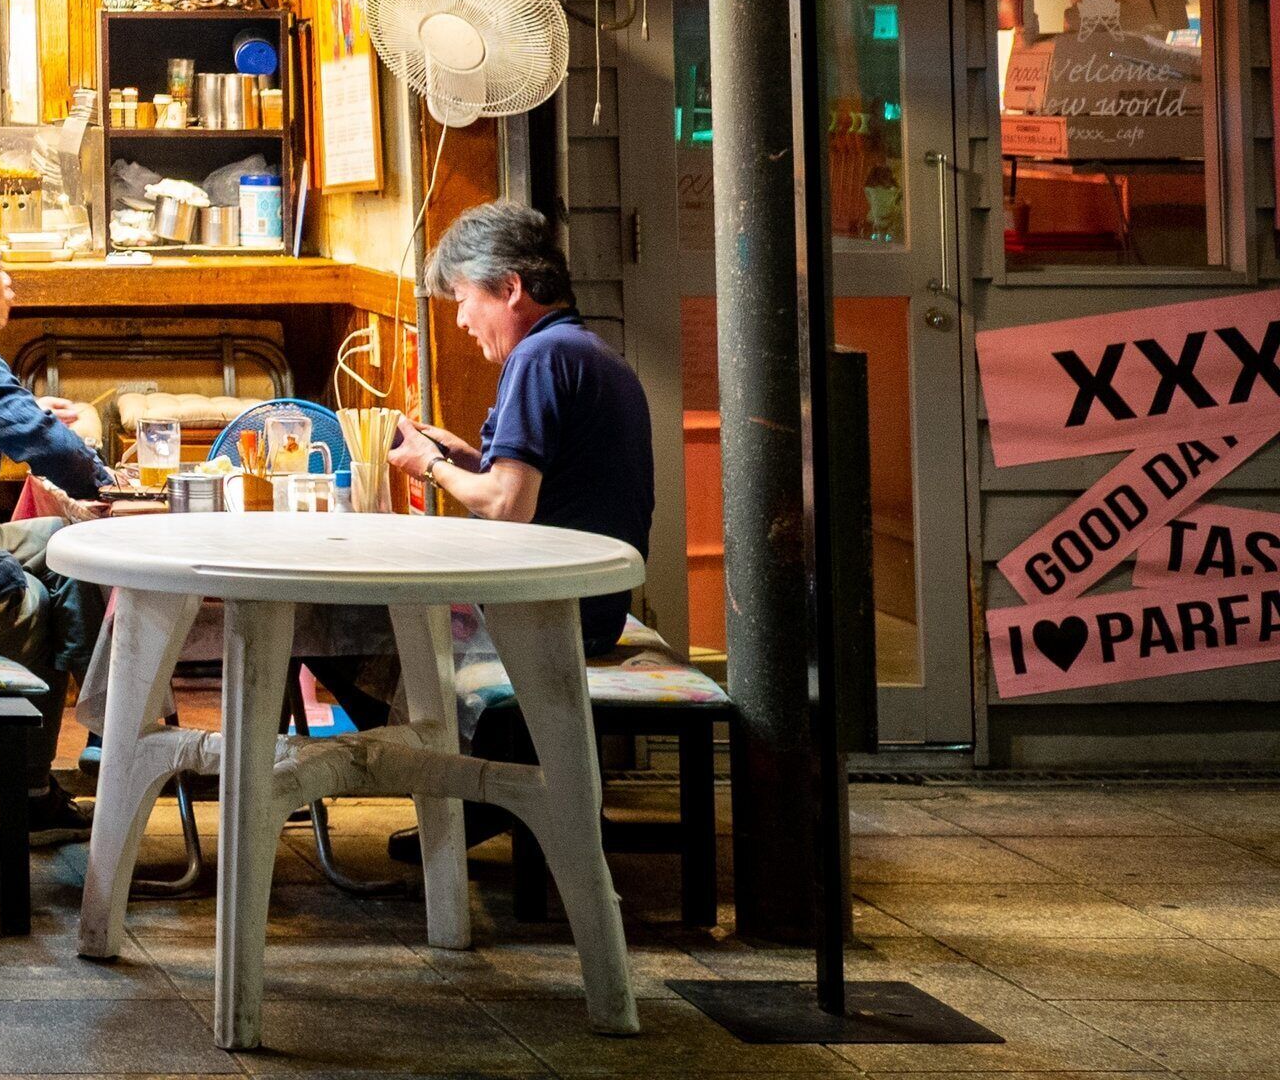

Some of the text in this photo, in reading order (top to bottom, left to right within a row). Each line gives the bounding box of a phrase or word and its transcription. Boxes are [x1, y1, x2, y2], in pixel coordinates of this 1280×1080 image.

[1095, 86, 1188, 118] world
[1052, 321, 1280, 429] XXX
[1024, 435, 1238, 597] GOOD DA
[1008, 624, 1027, 676] I
